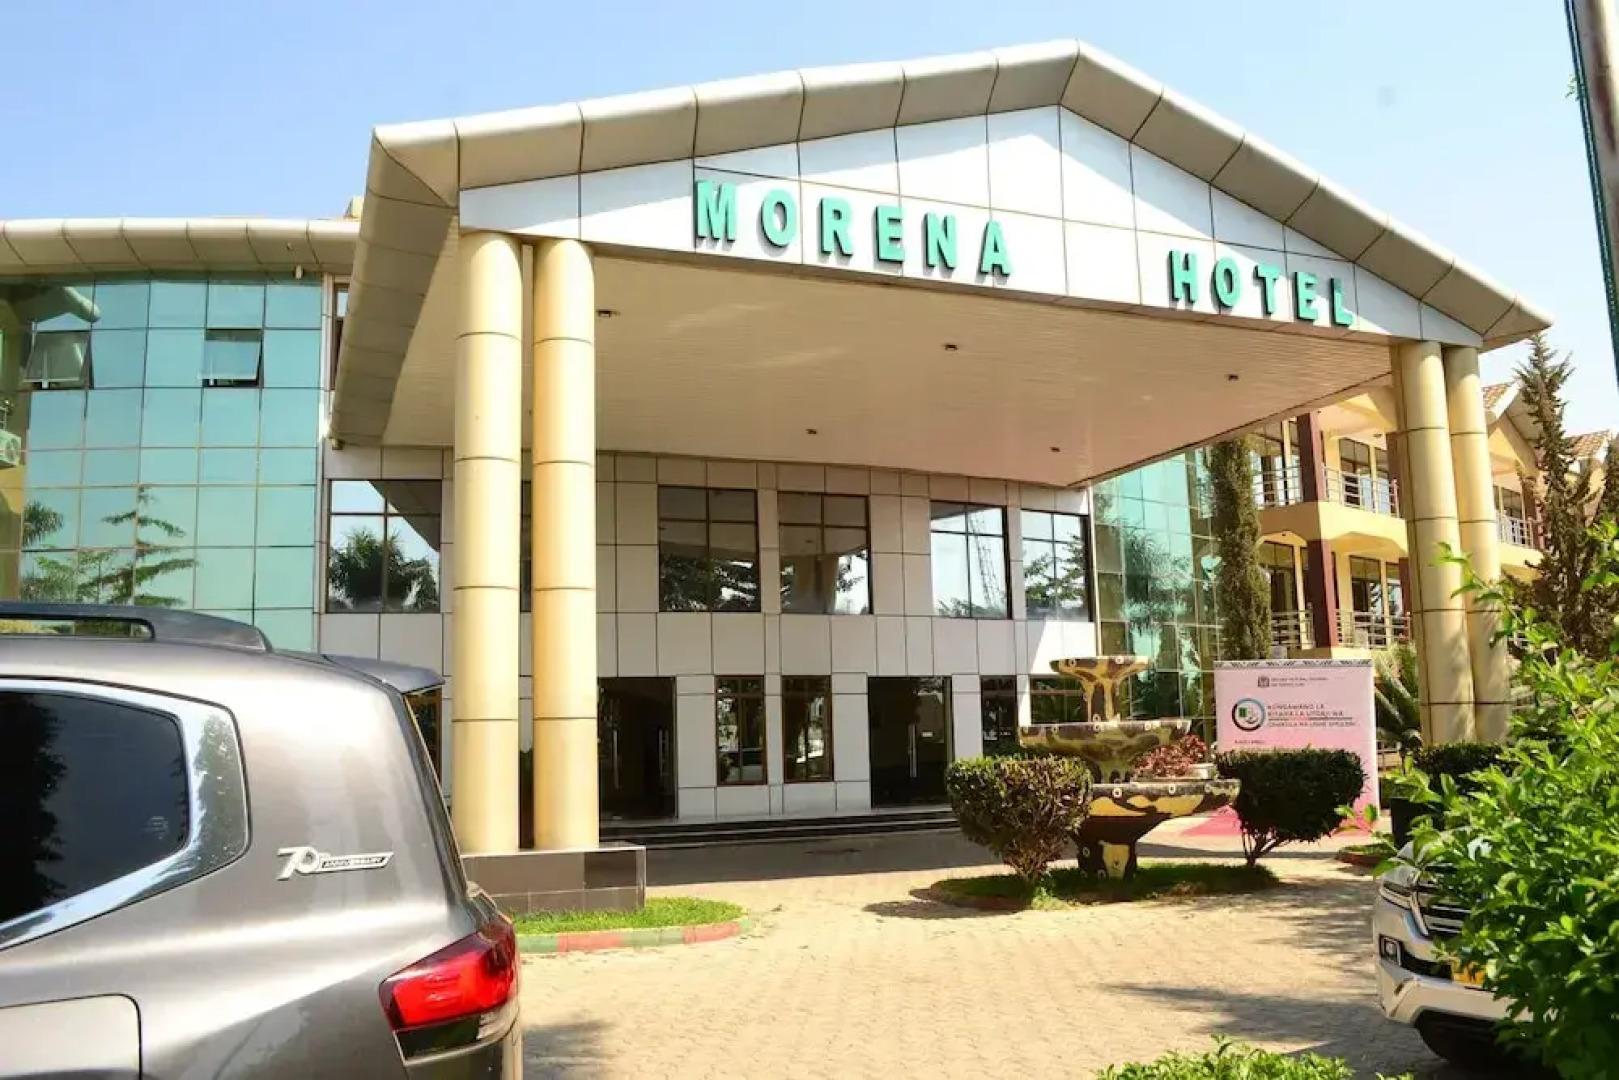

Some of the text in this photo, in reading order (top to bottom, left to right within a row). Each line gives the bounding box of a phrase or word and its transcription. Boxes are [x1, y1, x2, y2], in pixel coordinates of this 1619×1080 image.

[696, 179, 1353, 326] MORENA HOTEL
[277, 846, 319, 881] 70
